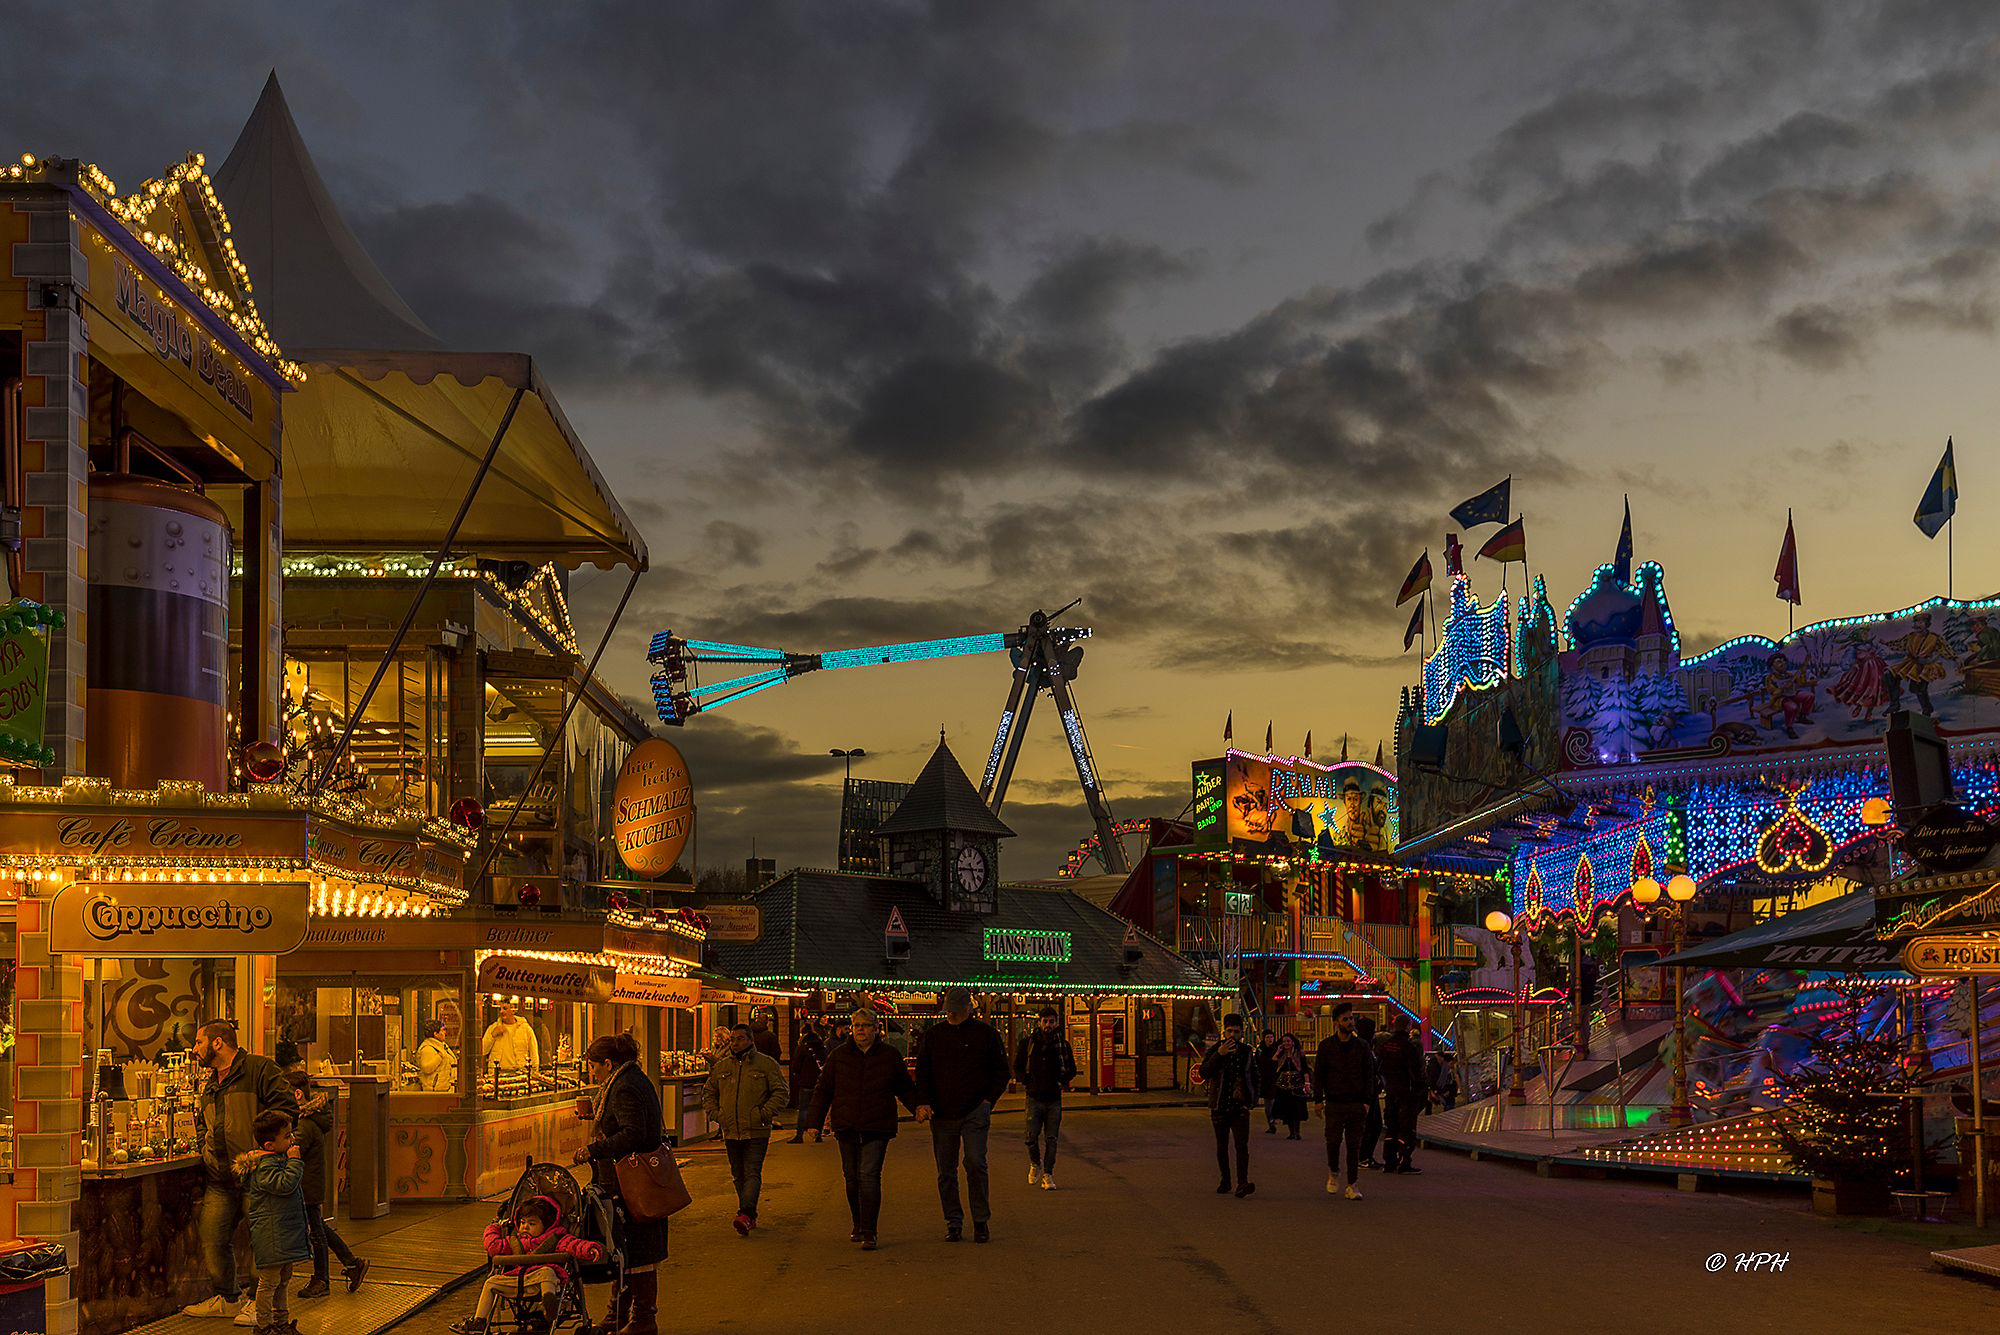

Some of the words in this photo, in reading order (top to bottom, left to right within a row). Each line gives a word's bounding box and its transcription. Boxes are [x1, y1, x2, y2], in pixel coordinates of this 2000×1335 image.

[114, 256, 193, 371] Magic
[198, 333, 254, 423] Bean
[625, 760, 656, 776] hier
[641, 766, 683, 787] heiße
[1267, 767, 1337, 816] REMMI
[616, 786, 690, 825] SCHMALZ
[1195, 796, 1215, 814] RAND
[1196, 814, 1217, 831] BAND
[1914, 824, 1940, 838] Bier
[57, 816, 134, 854] Café
[147, 817, 242, 848] Crème
[357, 839, 414, 874] Café
[83, 895, 272, 940] Cappuccino
[486, 927, 554, 944] Berliner
[990, 934, 1065, 957] HANSE-TRAIN
[1943, 946, 2000, 965] HOLST
[492, 982, 504, 990] mit
[505, 983, 529, 992] Kirsch
[633, 979, 668, 988] Hamburger
[609, 986, 690, 1005] chmalzkuchen
